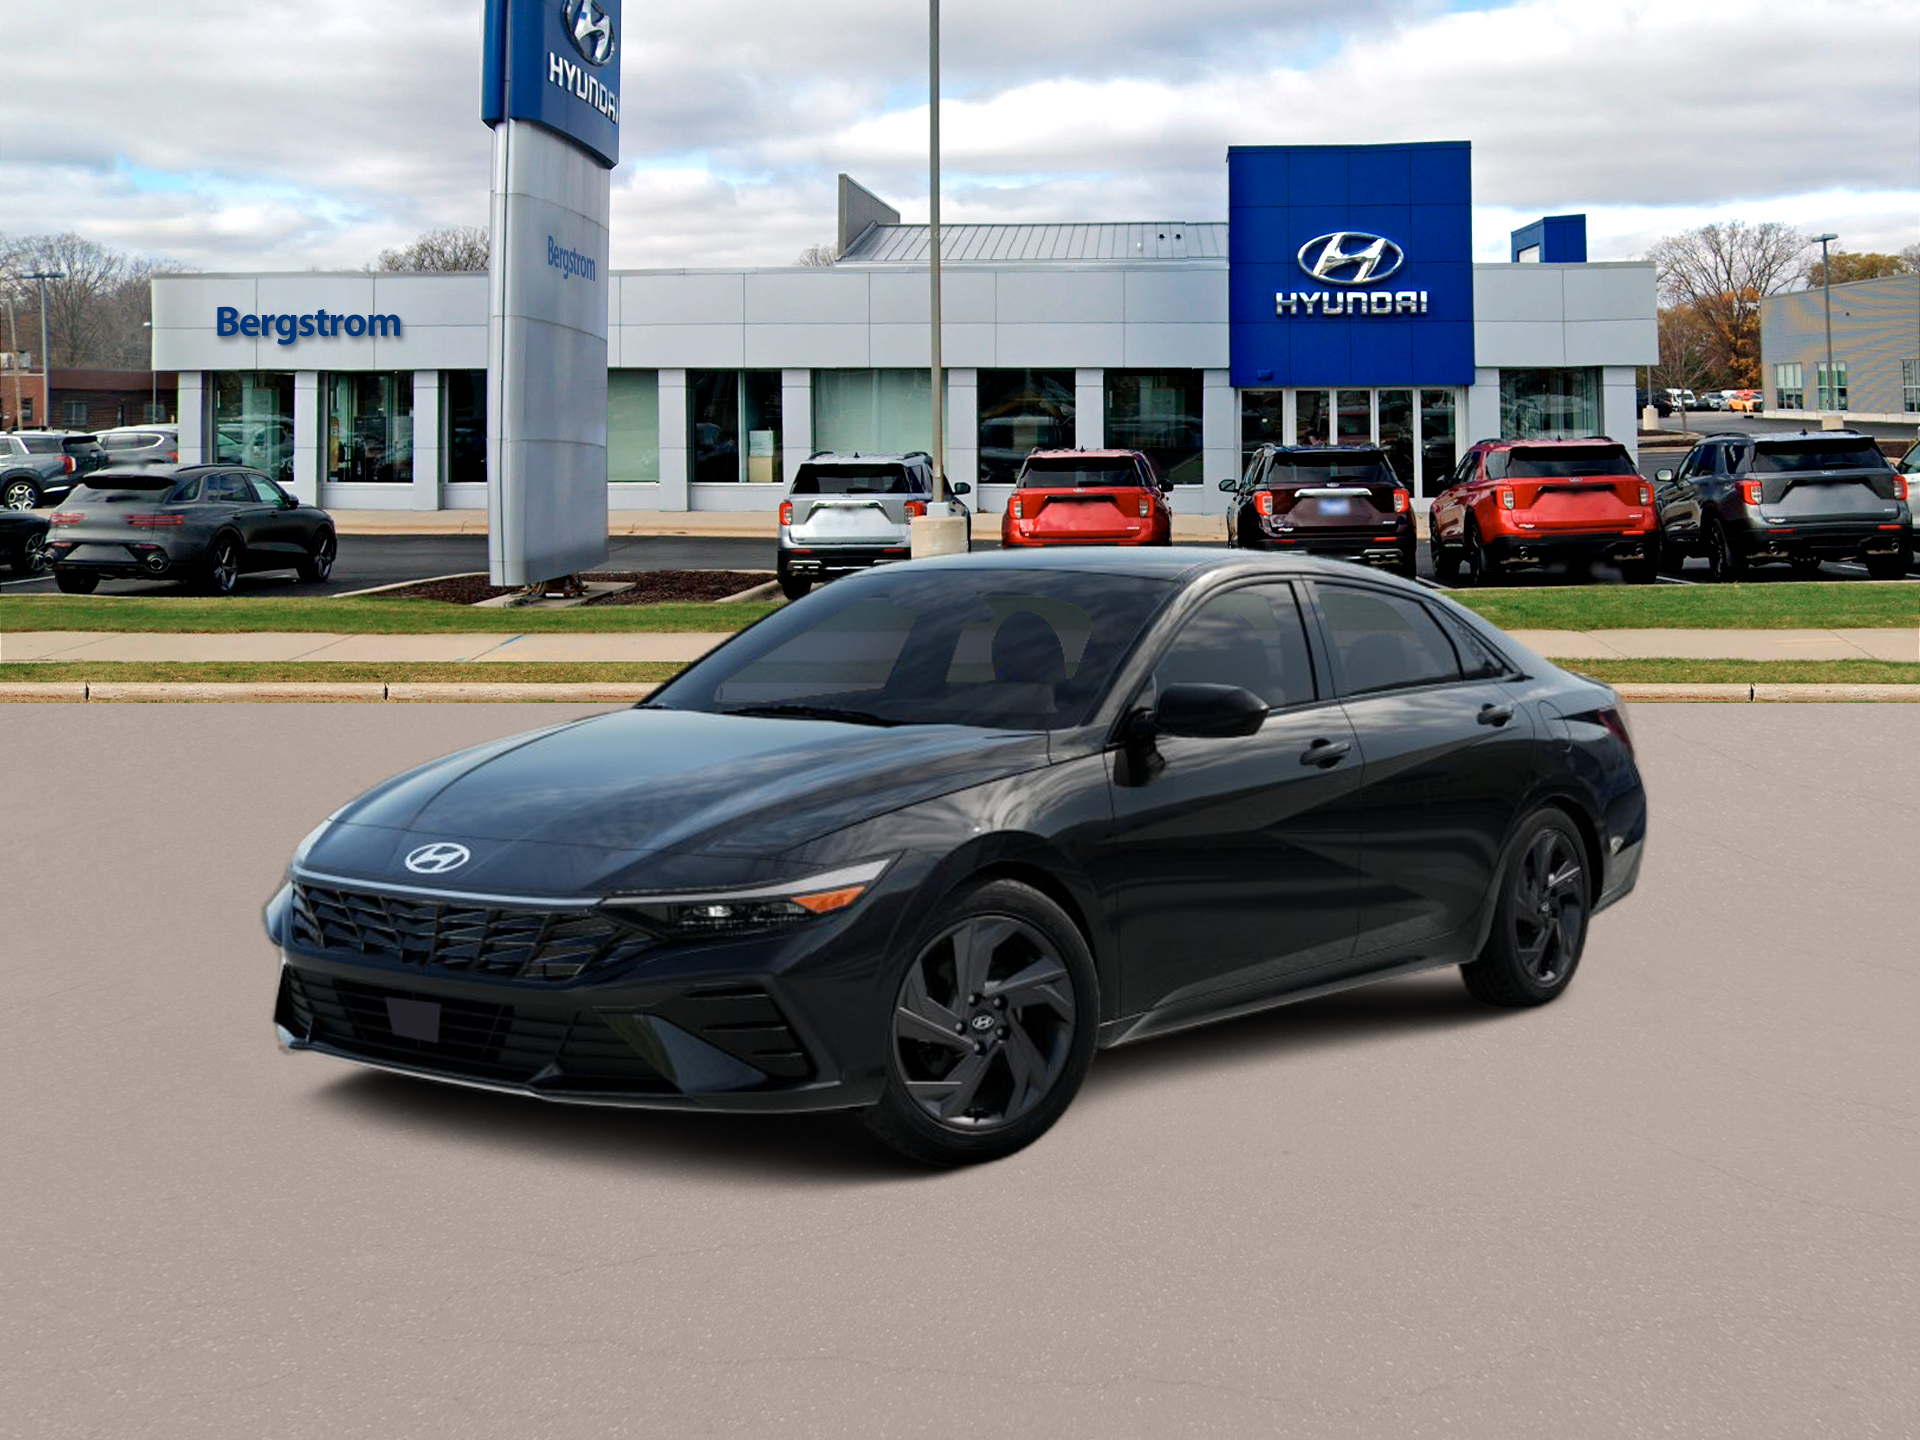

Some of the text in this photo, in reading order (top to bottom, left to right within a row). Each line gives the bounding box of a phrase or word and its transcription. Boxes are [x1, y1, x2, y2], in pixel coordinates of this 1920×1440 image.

[548, 235, 596, 282] Bergstrom
[1275, 291, 1428, 315] HYUNDAI
[217, 306, 401, 346] Bergstrom
